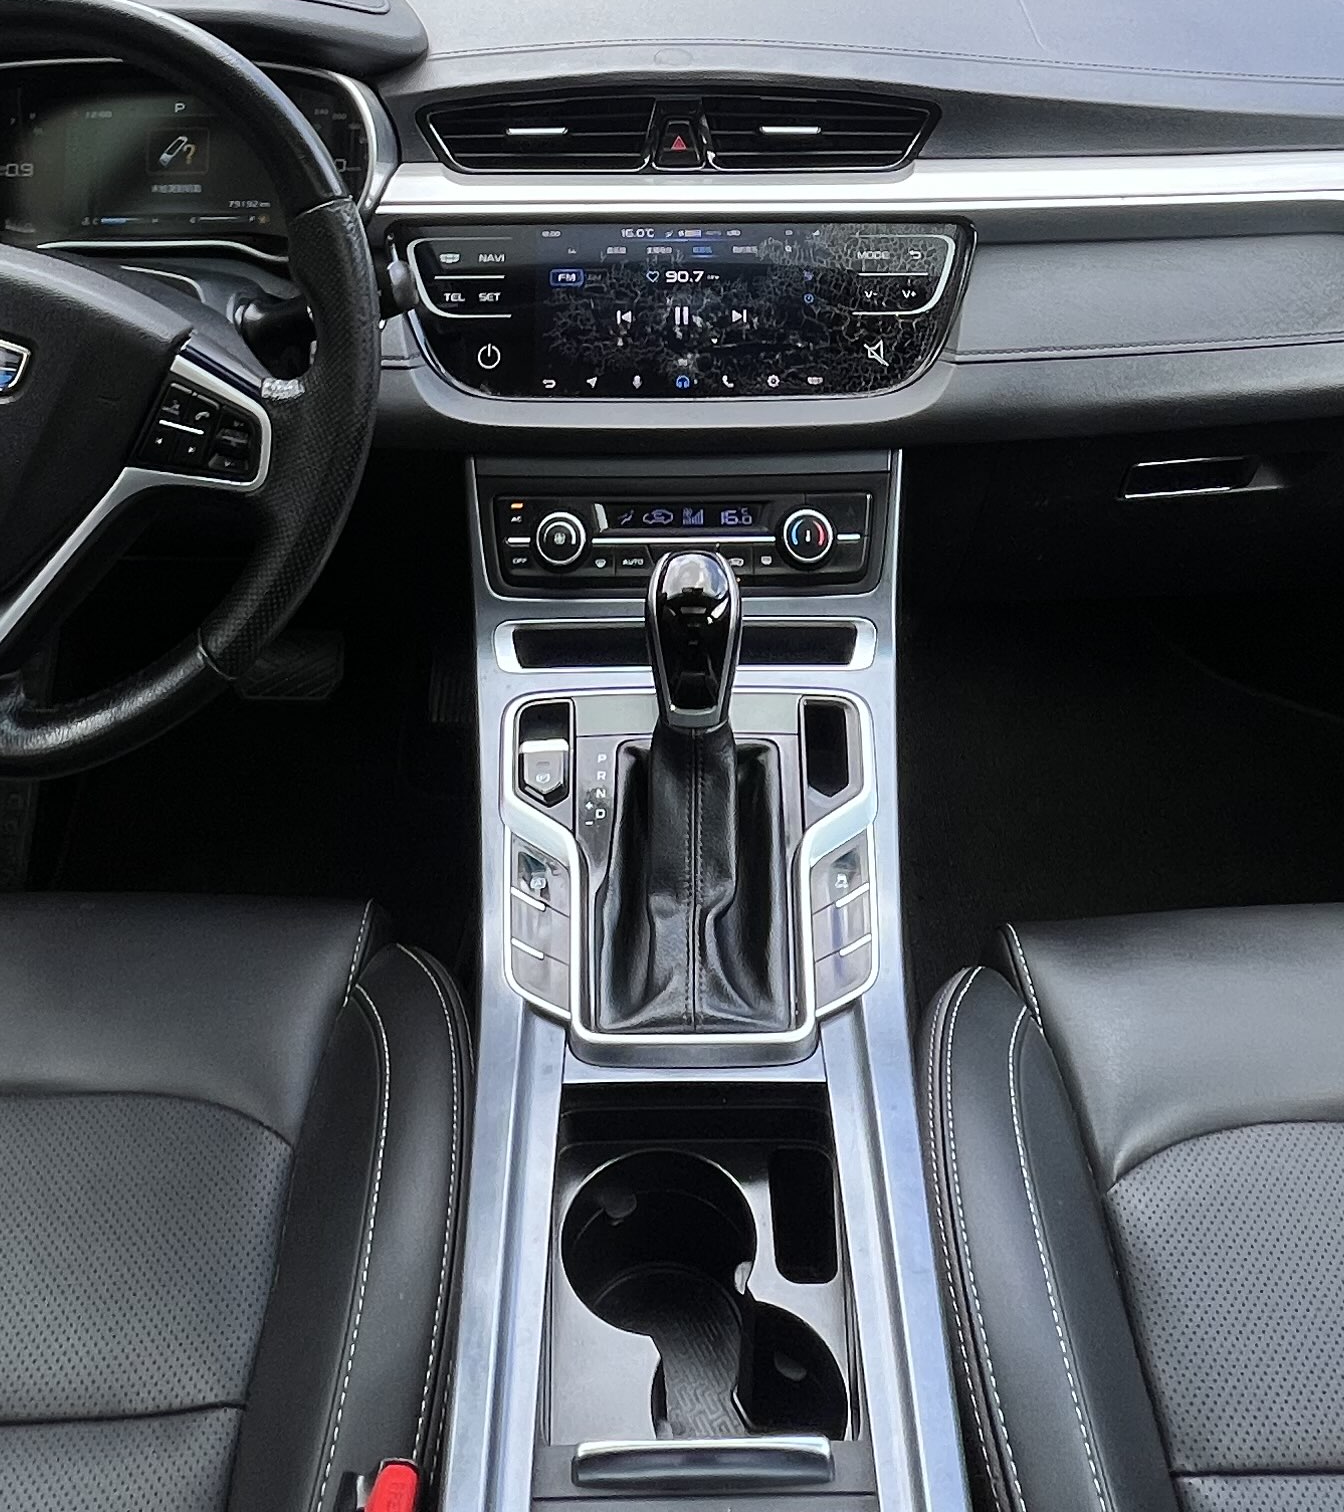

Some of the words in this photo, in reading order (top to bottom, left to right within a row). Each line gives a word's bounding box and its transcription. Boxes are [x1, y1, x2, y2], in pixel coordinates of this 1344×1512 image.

[174, 102, 186, 113] P
[478, 253, 506, 263] NAVI
[857, 250, 891, 260] MODE
[557, 273, 577, 282] FM
[665, 270, 705, 284] 90.7
[443, 292, 466, 302] TEL
[478, 292, 502, 302] SET
[512, 557, 528, 565] OFF
[622, 558, 645, 566] AUTO
[597, 753, 607, 763] P
[596, 771, 607, 781] R
[595, 788, 606, 799] N
[595, 809, 606, 819] D
